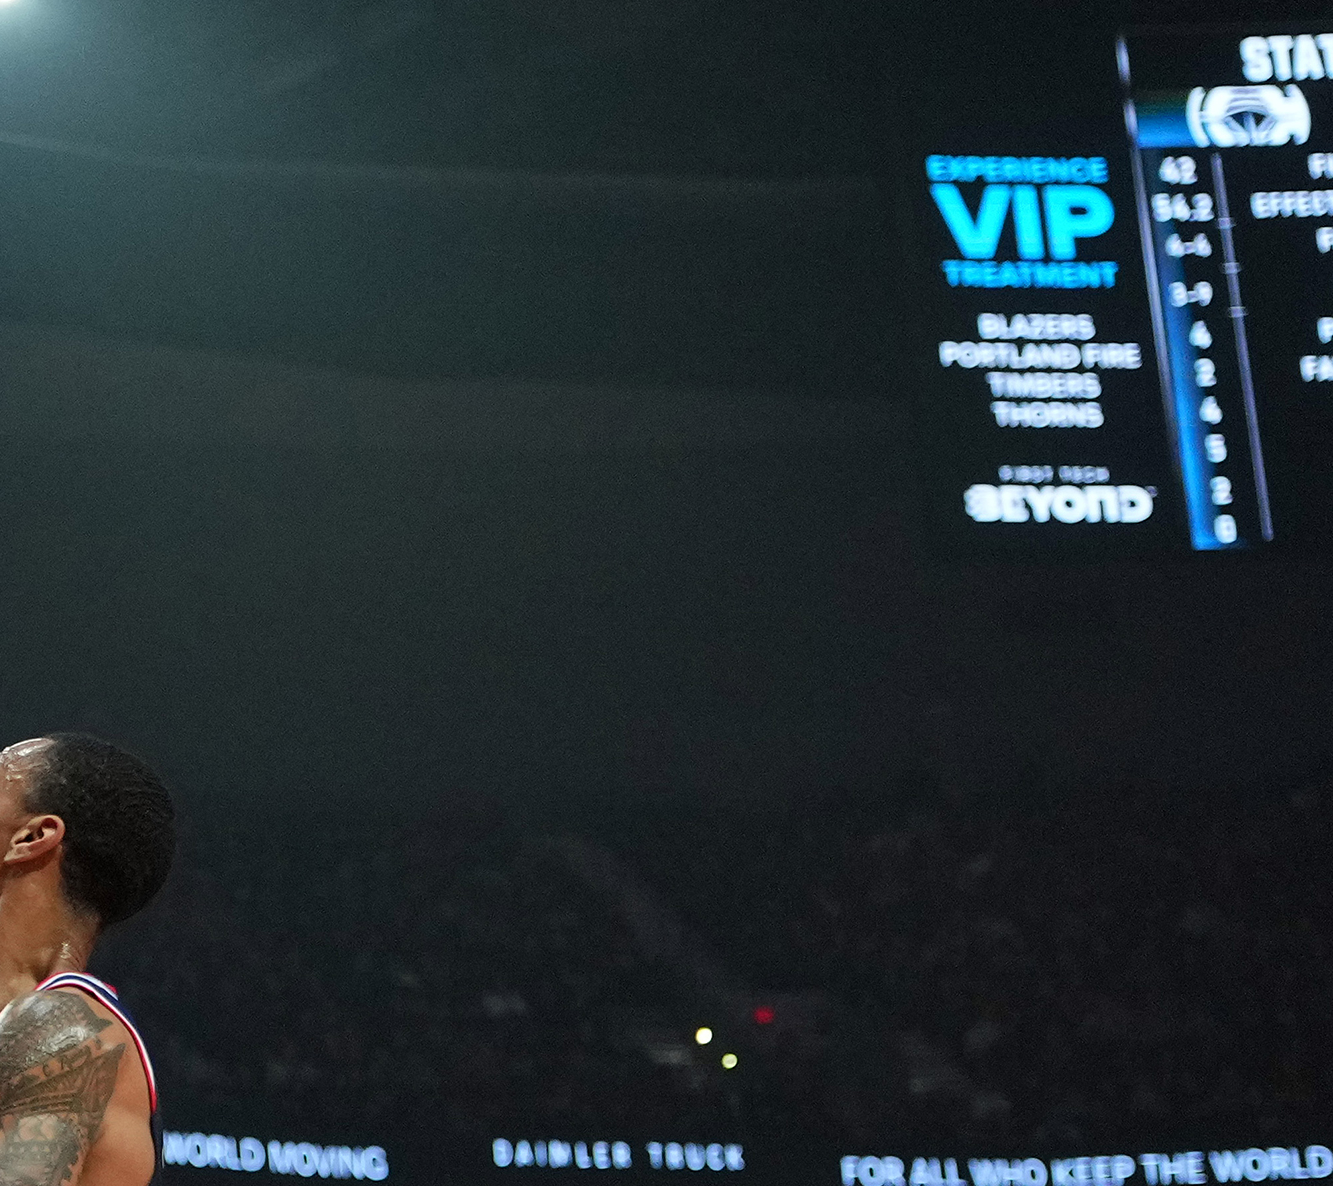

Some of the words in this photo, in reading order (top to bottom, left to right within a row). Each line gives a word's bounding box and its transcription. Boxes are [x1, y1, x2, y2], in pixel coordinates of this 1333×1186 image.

[925, 155, 1109, 183] EXPERIENCE
[930, 183, 1115, 260] VIP
[940, 260, 1120, 288] TREATMENT
[977, 312, 1096, 341] BLAZERS
[938, 340, 1081, 369] PORTLAND
[1081, 342, 1142, 369] FIRE
[985, 371, 1102, 399] TIMBERS
[990, 401, 1104, 428] THORNS
[963, 483, 1154, 523] BEYOND
[162, 1130, 266, 1172] WORLD
[267, 1139, 389, 1181] MOVING
[492, 1138, 632, 1170] DAIMLER
[646, 1141, 745, 1171] TRUCK
[1139, 1151, 1208, 1186] THE
[1208, 1144, 1333, 1183] WORLD
